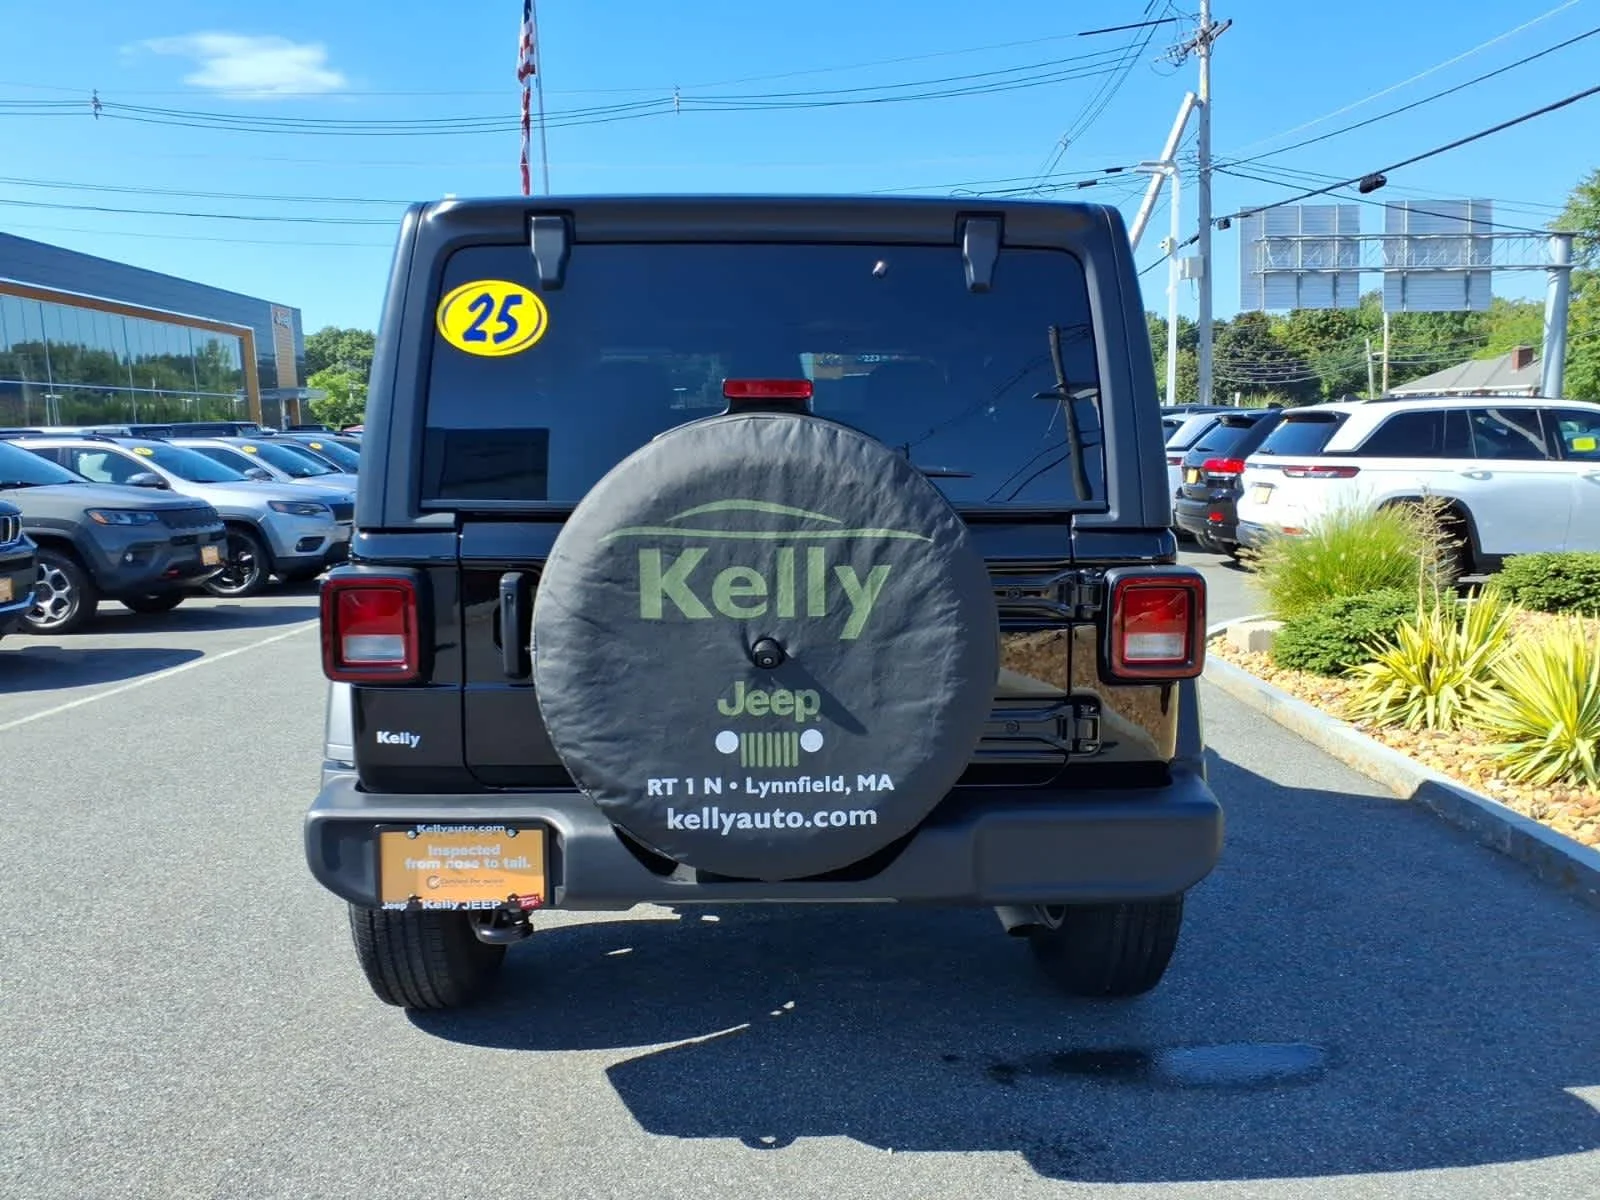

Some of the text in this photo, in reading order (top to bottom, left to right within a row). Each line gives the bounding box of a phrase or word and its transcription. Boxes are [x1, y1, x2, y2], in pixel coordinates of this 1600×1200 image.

[463, 292, 523, 345] 25
[638, 546, 893, 640] Kelly
[717, 680, 822, 723] Jeep
[376, 730, 421, 748] Kelly
[647, 774, 895, 798] RT 1 N Lynnfield, MA
[416, 824, 506, 834] Kellyauto.com
[667, 806, 878, 836] kellyauto.com
[428, 844, 501, 859] Inspected
[405, 858, 441, 870] from
[484, 857, 499, 869] to
[503, 856, 532, 869] tail.
[381, 900, 502, 911] Jeep Kelly JEEP
